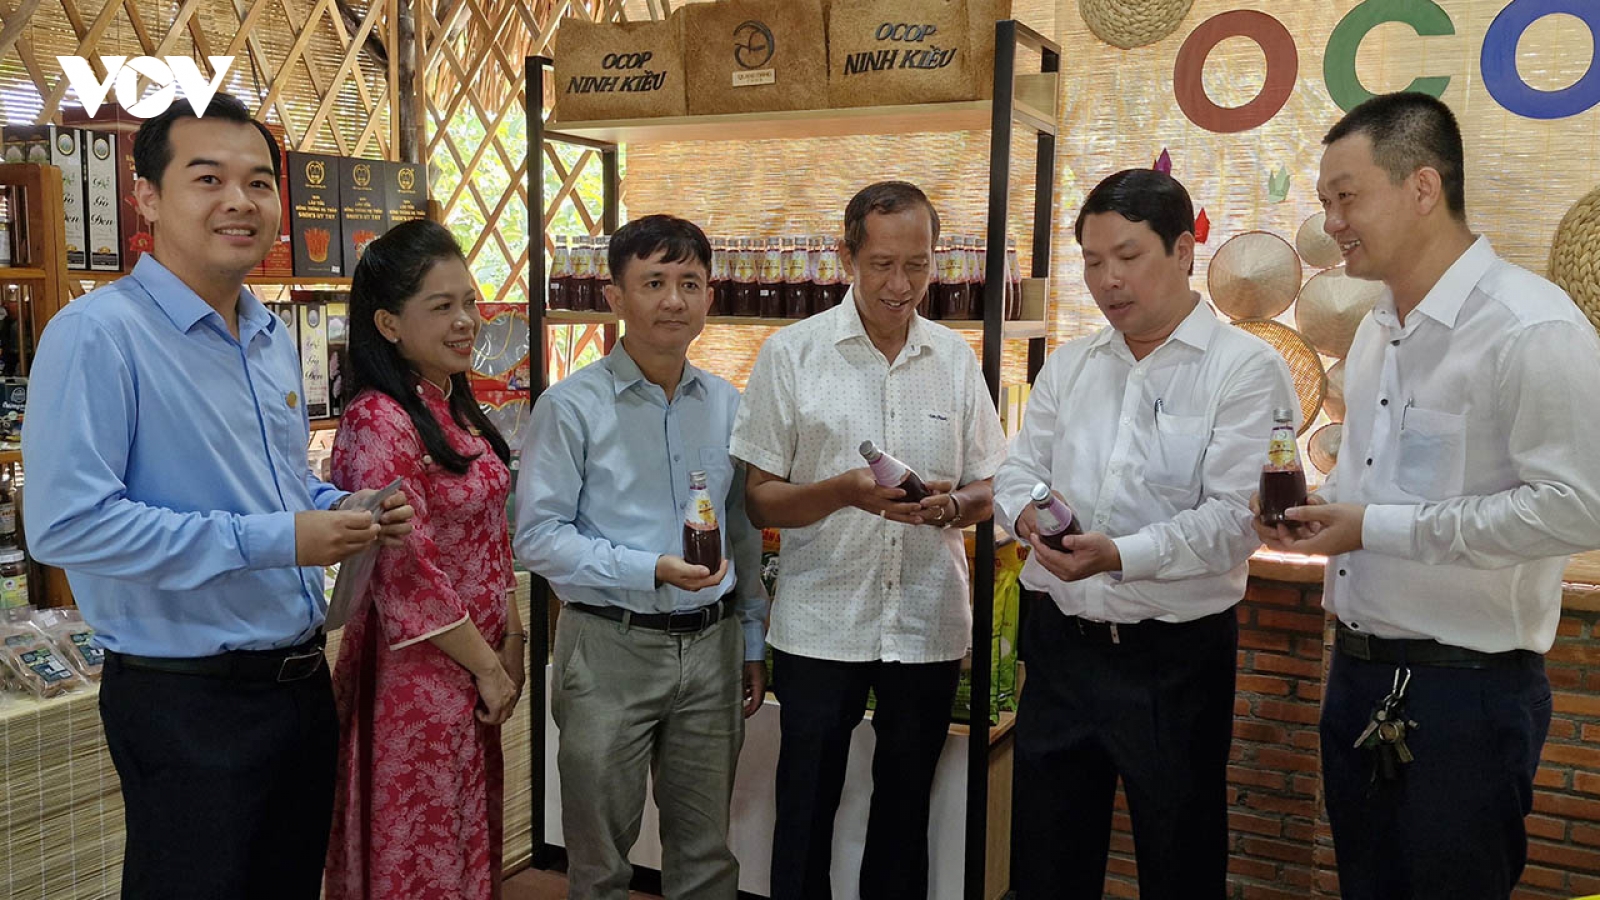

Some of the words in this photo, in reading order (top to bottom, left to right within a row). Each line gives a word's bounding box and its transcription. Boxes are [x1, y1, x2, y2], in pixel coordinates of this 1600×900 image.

[875, 22, 937, 42] OCOP
[602, 51, 653, 70] OCOP
[843, 49, 900, 75] NINH
[898, 44, 958, 70] KIỀU
[566, 76, 621, 94] NINH
[619, 69, 667, 92] KIỀU
